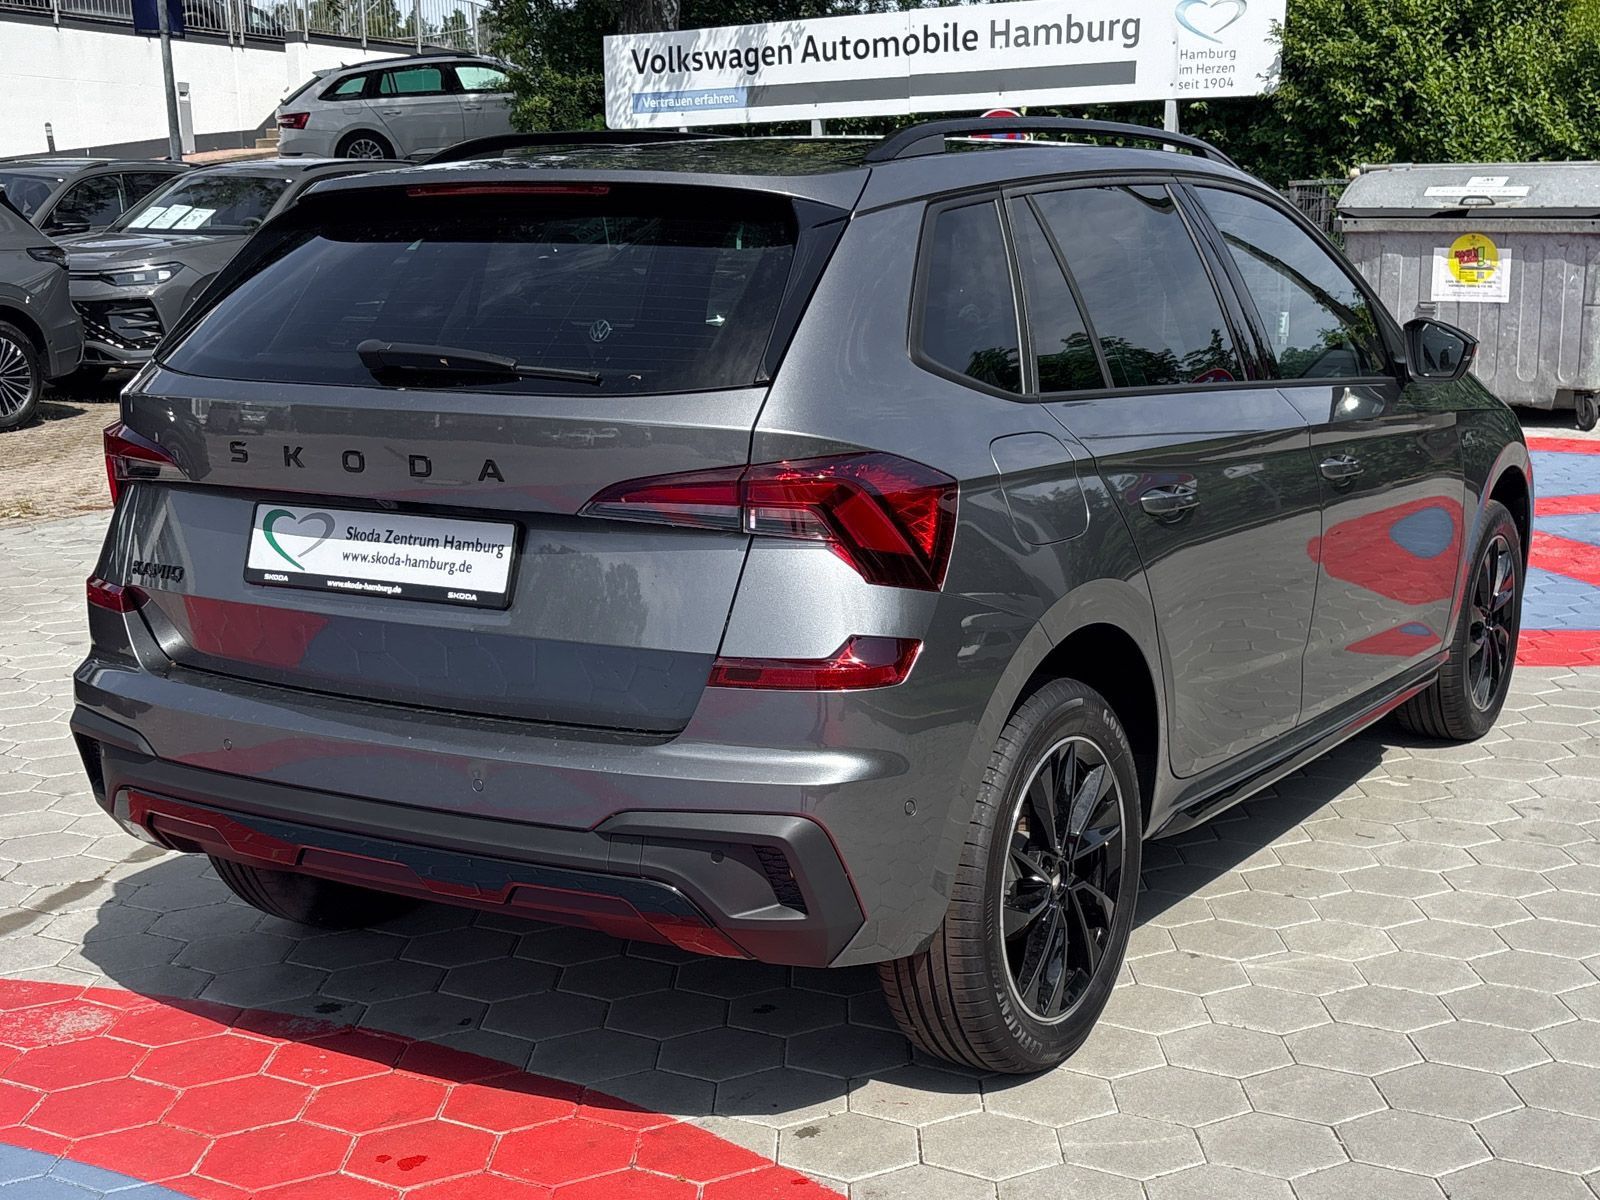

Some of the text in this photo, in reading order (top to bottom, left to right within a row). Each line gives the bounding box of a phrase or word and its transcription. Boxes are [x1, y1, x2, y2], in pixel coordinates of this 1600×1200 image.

[631, 13, 1141, 76] Volkswagen Automobile Hamburg
[1180, 48, 1237, 61] Hamburg
[1179, 63, 1236, 75] im Herzen
[1178, 77, 1234, 90] seit 1904
[642, 93, 739, 108] Vertrauen erfahren.
[345, 526, 505, 559] Skoda Zentrum Hamburg
[342, 550, 473, 576] www.skoda-hamburg.de
[327, 579, 402, 595] www.skoda-hamburg.de
